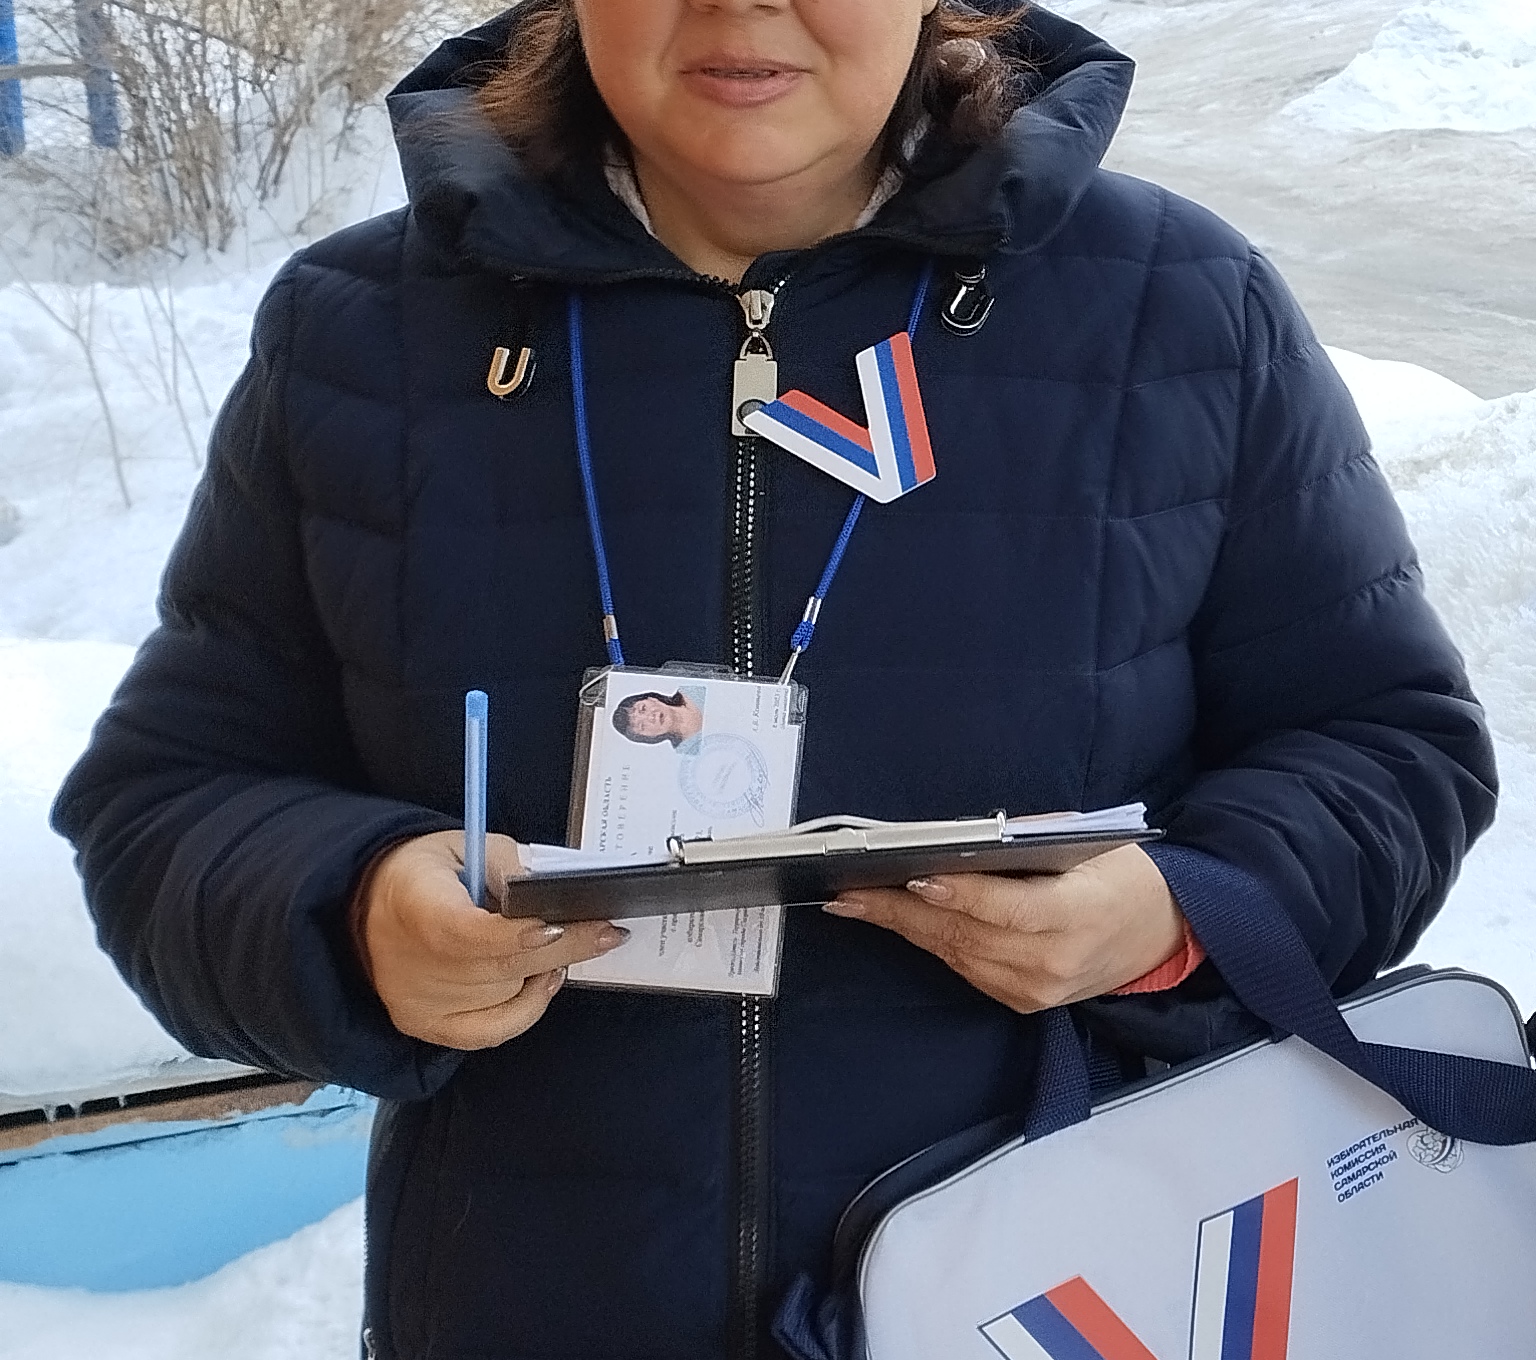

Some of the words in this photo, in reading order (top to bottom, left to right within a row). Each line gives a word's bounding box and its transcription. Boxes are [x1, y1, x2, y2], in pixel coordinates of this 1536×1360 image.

[1326, 1117, 1420, 1168] ИЗБИРАТЕЛЬНАЯ
[1330, 1143, 1387, 1180] КОМИССИЯ
[1333, 1150, 1398, 1191] САМАРСКОЙ
[1337, 1171, 1385, 1203] ОБЛАСТИ
